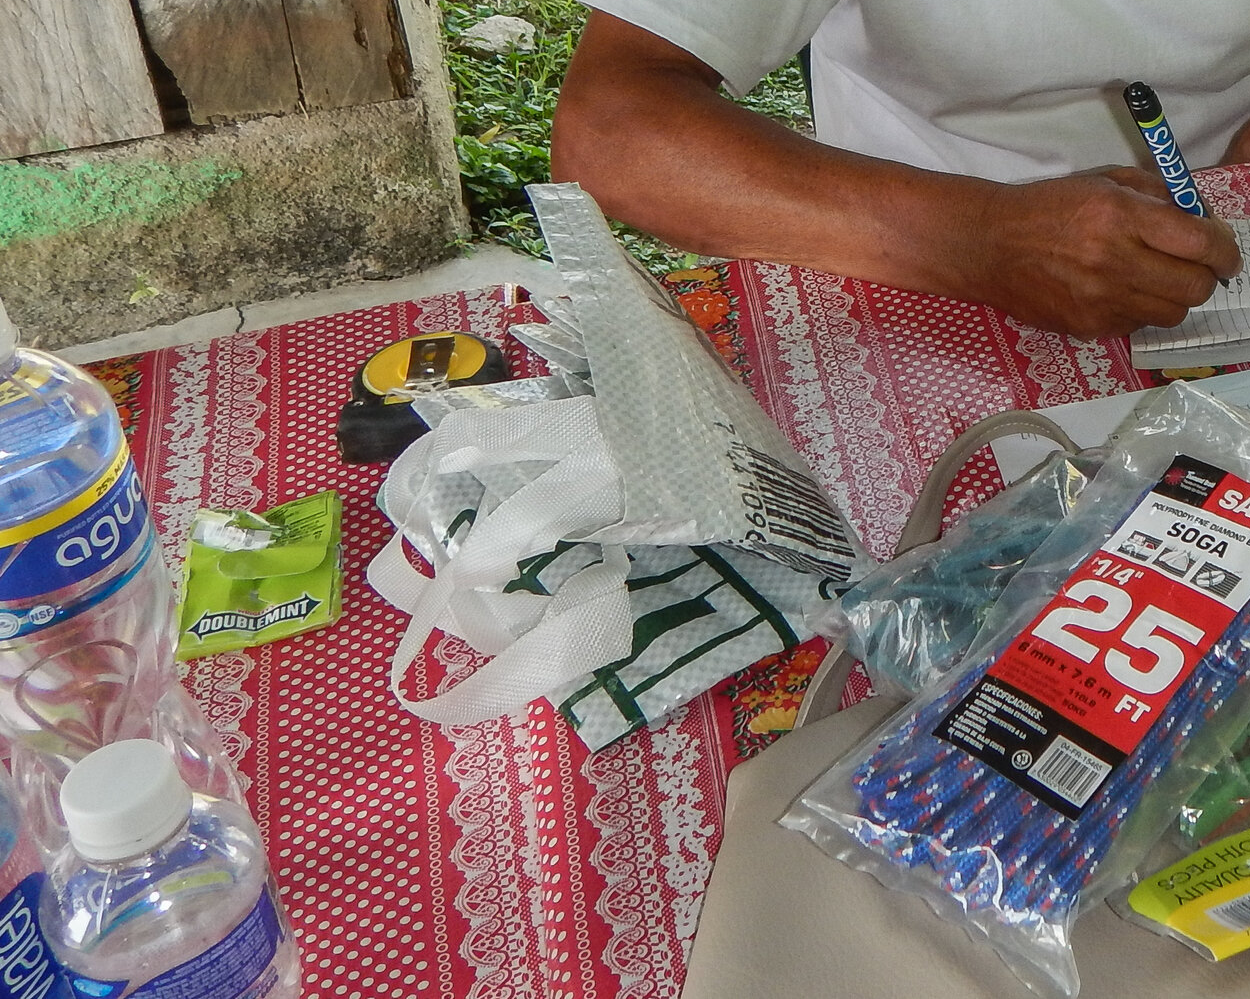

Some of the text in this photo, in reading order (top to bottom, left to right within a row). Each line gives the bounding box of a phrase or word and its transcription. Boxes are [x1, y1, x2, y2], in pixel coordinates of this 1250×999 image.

[55, 471, 143, 567] agua
[1209, 521, 1246, 543] DIAMOND
[1166, 522, 1229, 559] SOGA
[198, 599, 310, 634] DOUBLEMINT
[1031, 578, 1207, 695] 25
[1030, 649, 1056, 668] mm
[1097, 686, 1112, 700] m
[1114, 694, 1152, 723] FT
